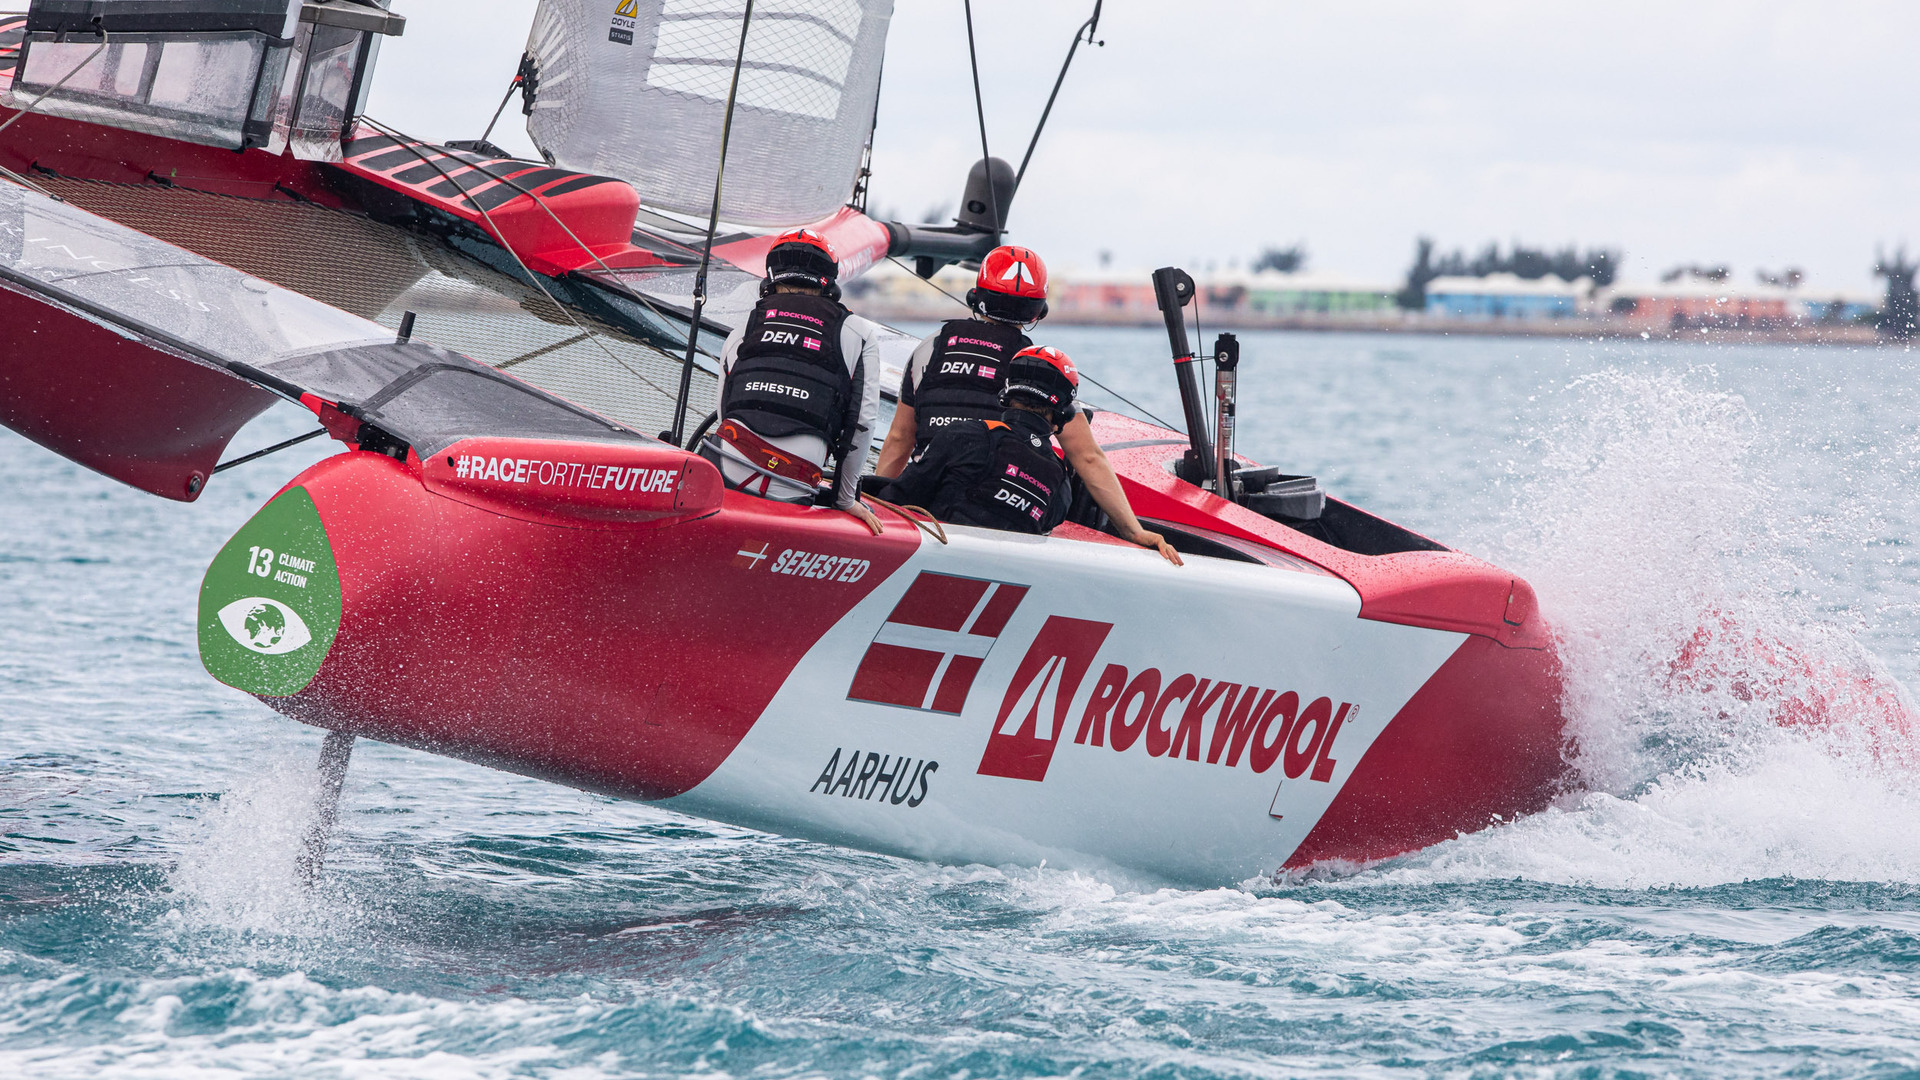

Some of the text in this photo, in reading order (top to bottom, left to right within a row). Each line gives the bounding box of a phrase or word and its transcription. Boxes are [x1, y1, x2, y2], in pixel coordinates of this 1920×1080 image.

[612, 18, 635, 29] DOYLE
[778, 311, 824, 327] ROCKWOOL
[760, 330, 800, 346] DEN
[958, 337, 1003, 352] ROCKWOOL
[939, 361, 976, 375] DEN
[744, 381, 810, 400] SEHESTED
[456, 454, 679, 494] #RACEFORTHEFUTURE
[993, 488, 1031, 512] DEN
[247, 545, 275, 578] 13
[278, 553, 317, 574] CLIMATE
[770, 548, 871, 583] SEHESTED
[273, 569, 308, 589] ACTION
[809, 747, 940, 808] AARHUS
